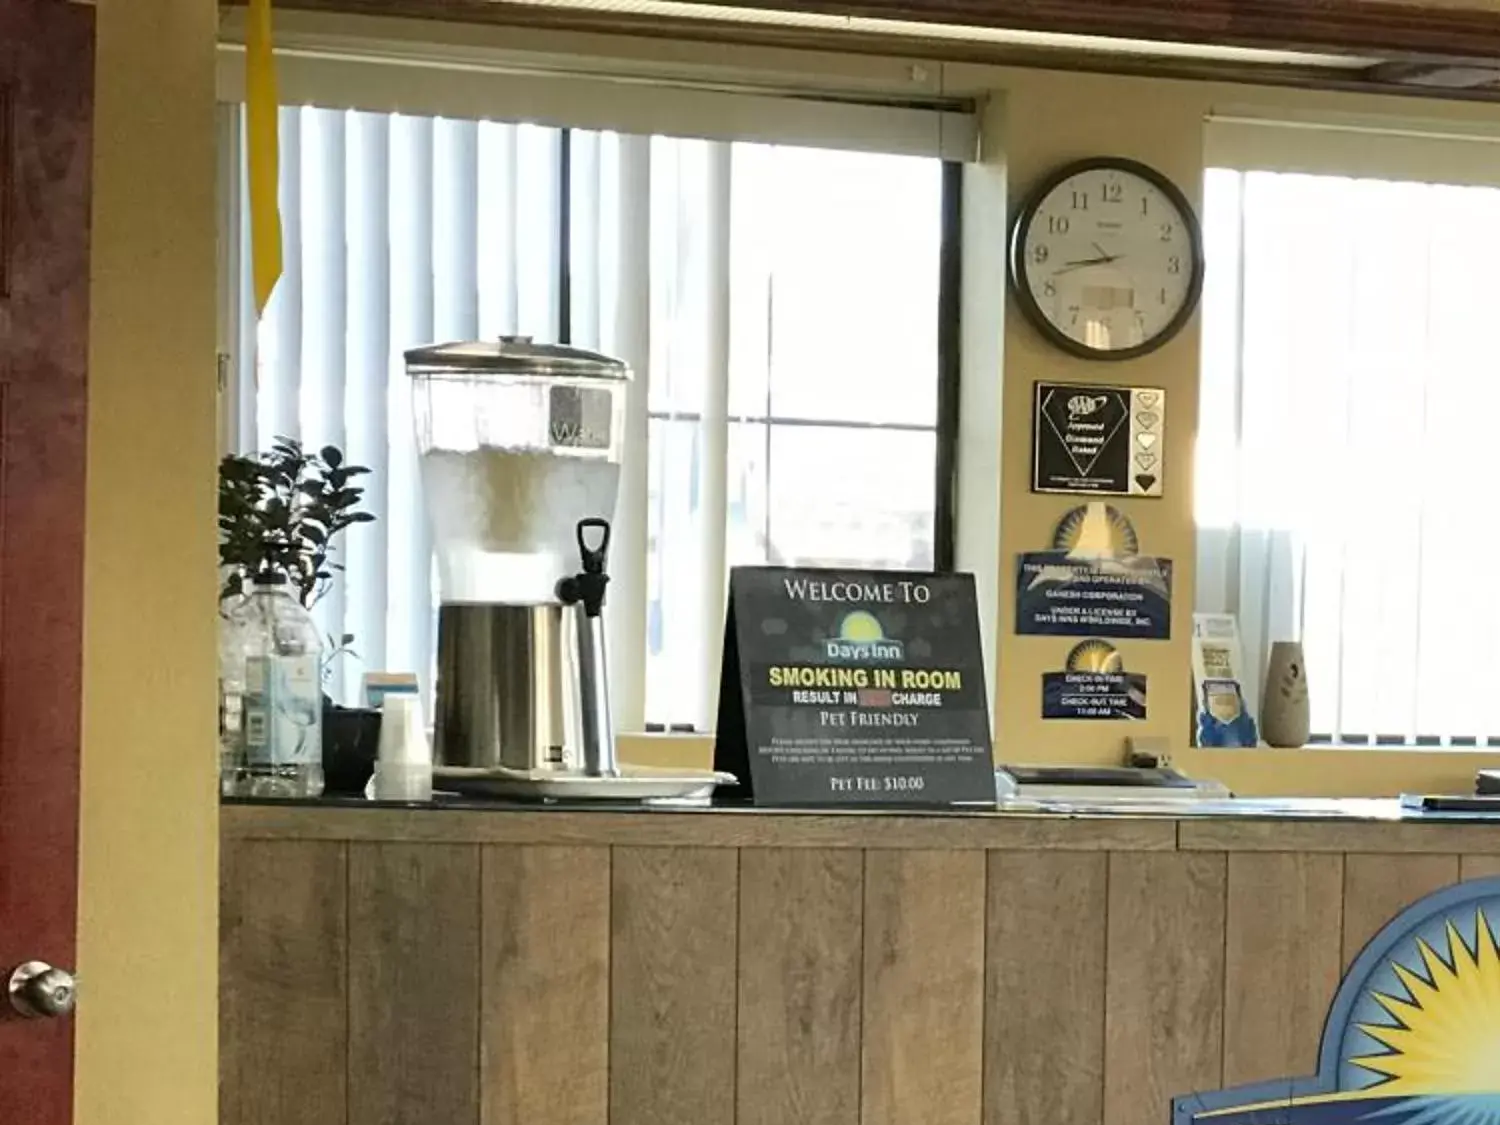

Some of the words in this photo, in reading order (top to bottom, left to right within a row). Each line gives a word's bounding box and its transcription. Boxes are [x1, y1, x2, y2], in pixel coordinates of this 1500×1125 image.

[1071, 191, 1089, 210] 11
[1102, 183, 1122, 203] 12
[1140, 196, 1148, 216] 1
[1049, 216, 1069, 235] 10
[1160, 224, 1172, 242] 2
[1035, 245, 1048, 263] 9
[1167, 256, 1179, 274] 3
[1044, 281, 1056, 297] 8
[1068, 305, 1080, 325] 7
[783, 578, 893, 602] WELCOME
[897, 581, 931, 603] TO
[769, 667, 868, 688] SMOKING
[874, 669, 898, 689] IN
[901, 670, 962, 690] ROOM
[792, 690, 840, 704] RESULT
[843, 691, 857, 705] IN
[891, 692, 942, 707] CHARGE
[819, 711, 846, 726] PET
[850, 711, 919, 728] FRIENDLY
